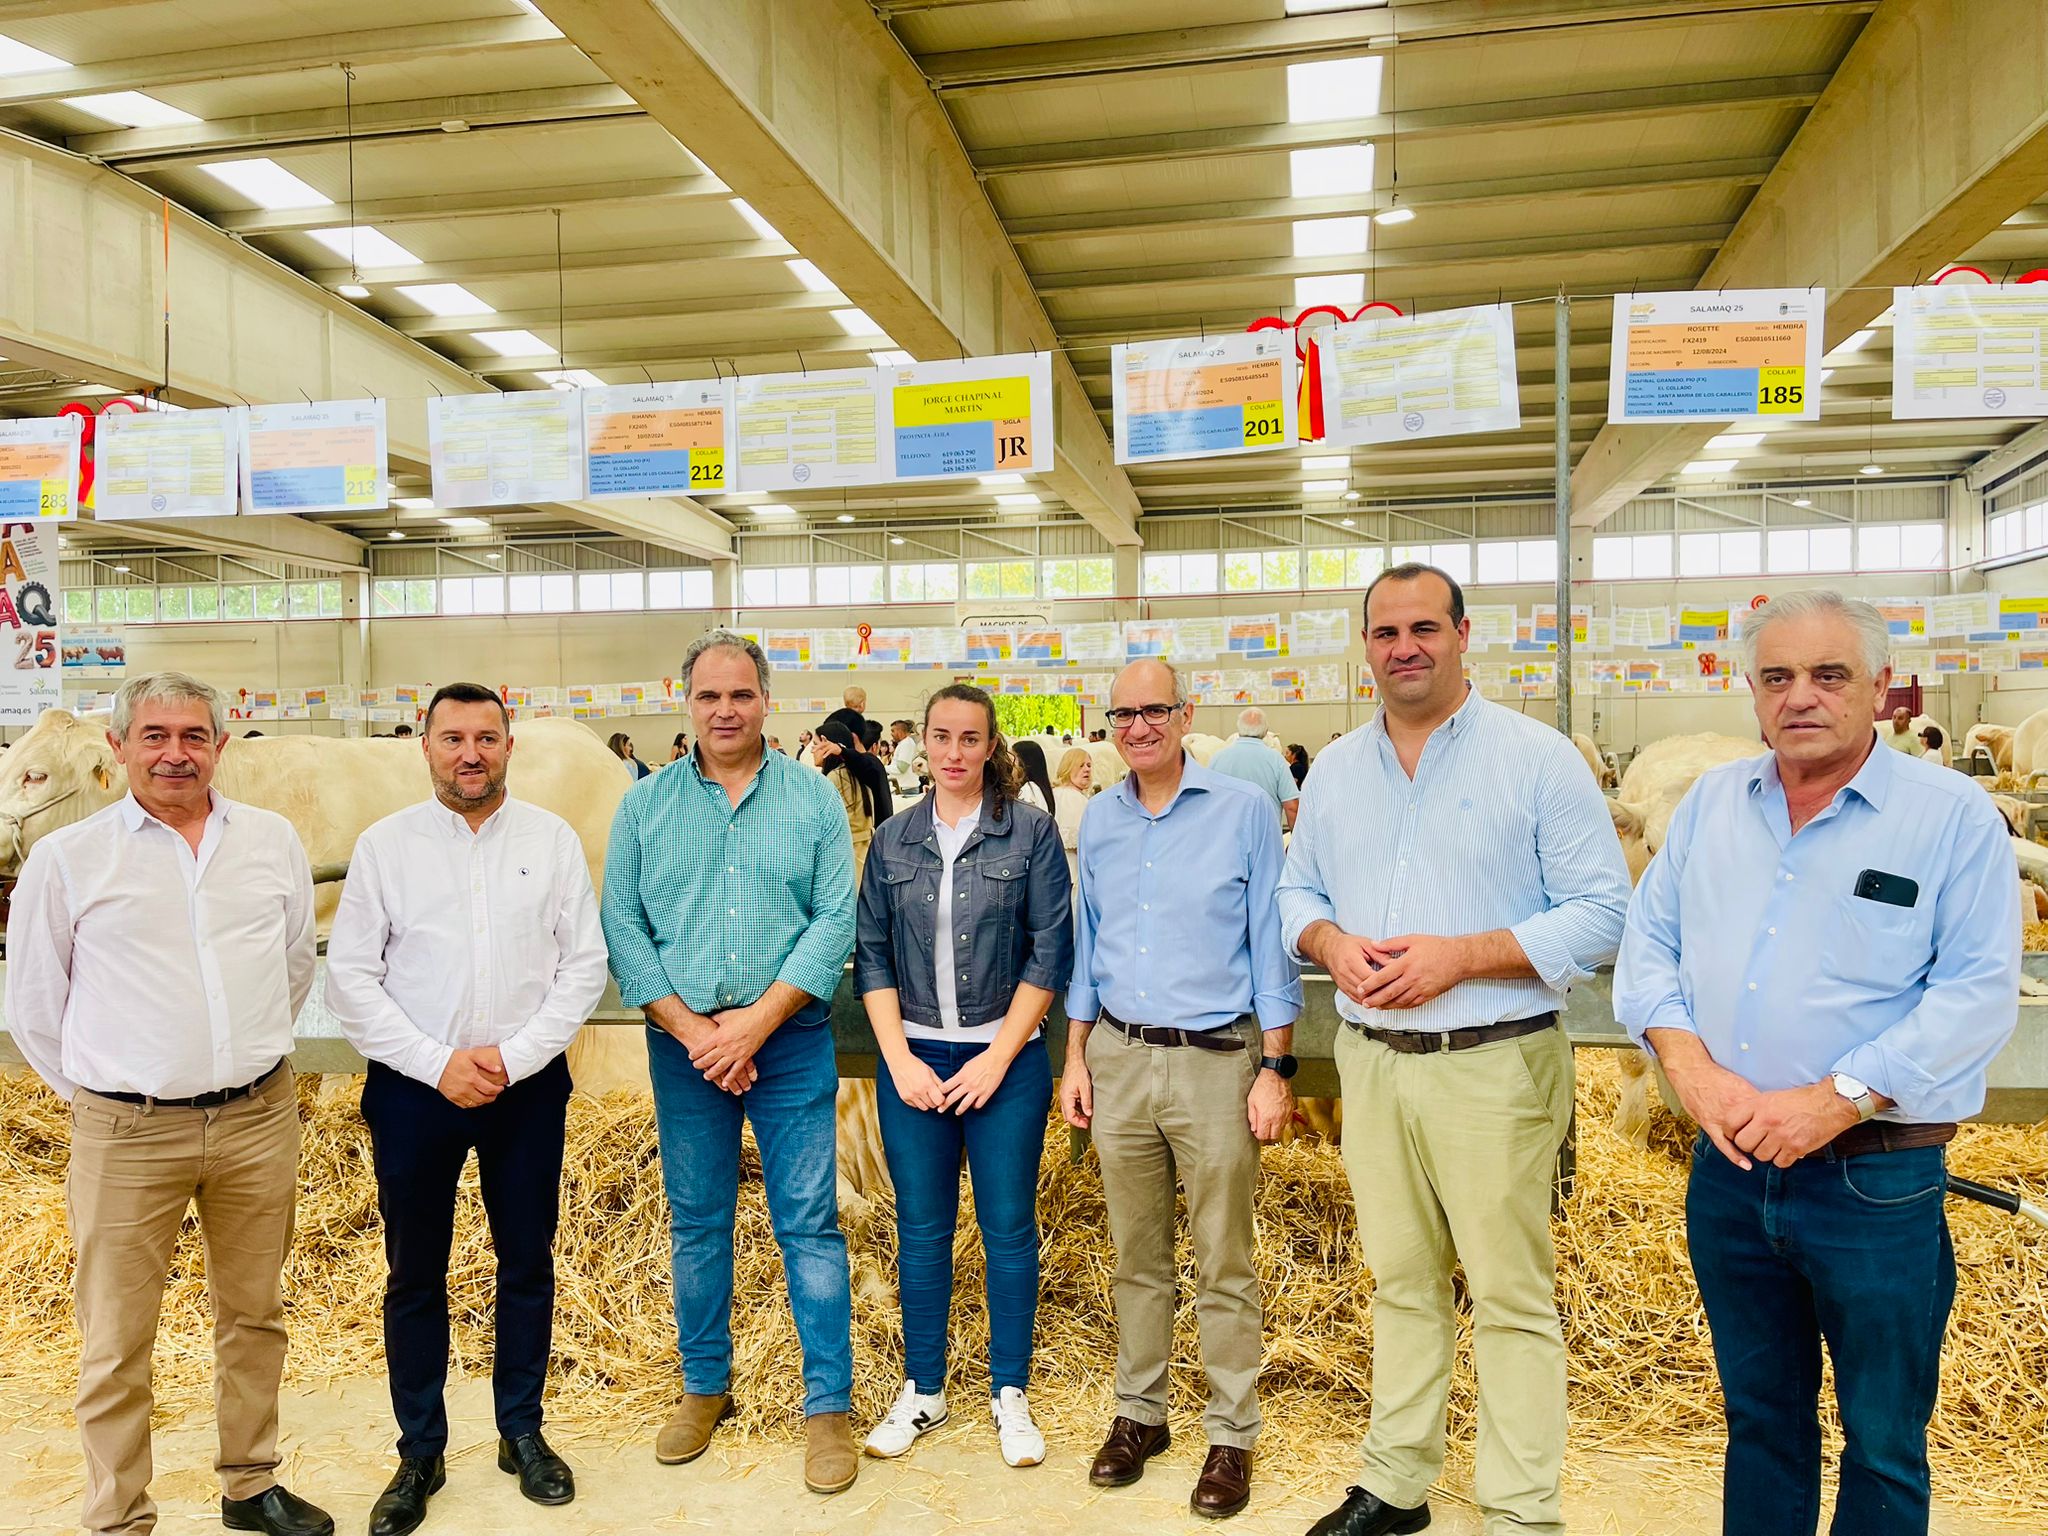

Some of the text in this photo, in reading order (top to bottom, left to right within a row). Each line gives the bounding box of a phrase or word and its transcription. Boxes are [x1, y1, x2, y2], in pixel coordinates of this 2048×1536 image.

[1690, 304, 1744, 313] SALAMAQ 25
[1215, 349, 1226, 357] 25
[1251, 361, 1280, 370] HEMBRA
[1767, 368, 1797, 376] COLLAR
[632, 395, 665, 403] SALAMAQ
[922, 391, 1004, 406] JORGE CHAPINAL
[1759, 385, 1803, 404] 185
[944, 404, 983, 415] MARTIN
[1250, 402, 1276, 411] COLLAR
[1002, 418, 1021, 426] SIGLA
[1244, 418, 1283, 438] 201
[942, 450, 953, 458] 619
[998, 436, 1028, 464] JR
[691, 464, 724, 481] 212
[346, 480, 376, 497] 213
[41, 493, 68, 508] 283
[14, 631, 56, 670] 25
[0, 707, 32, 715] amaq.es
